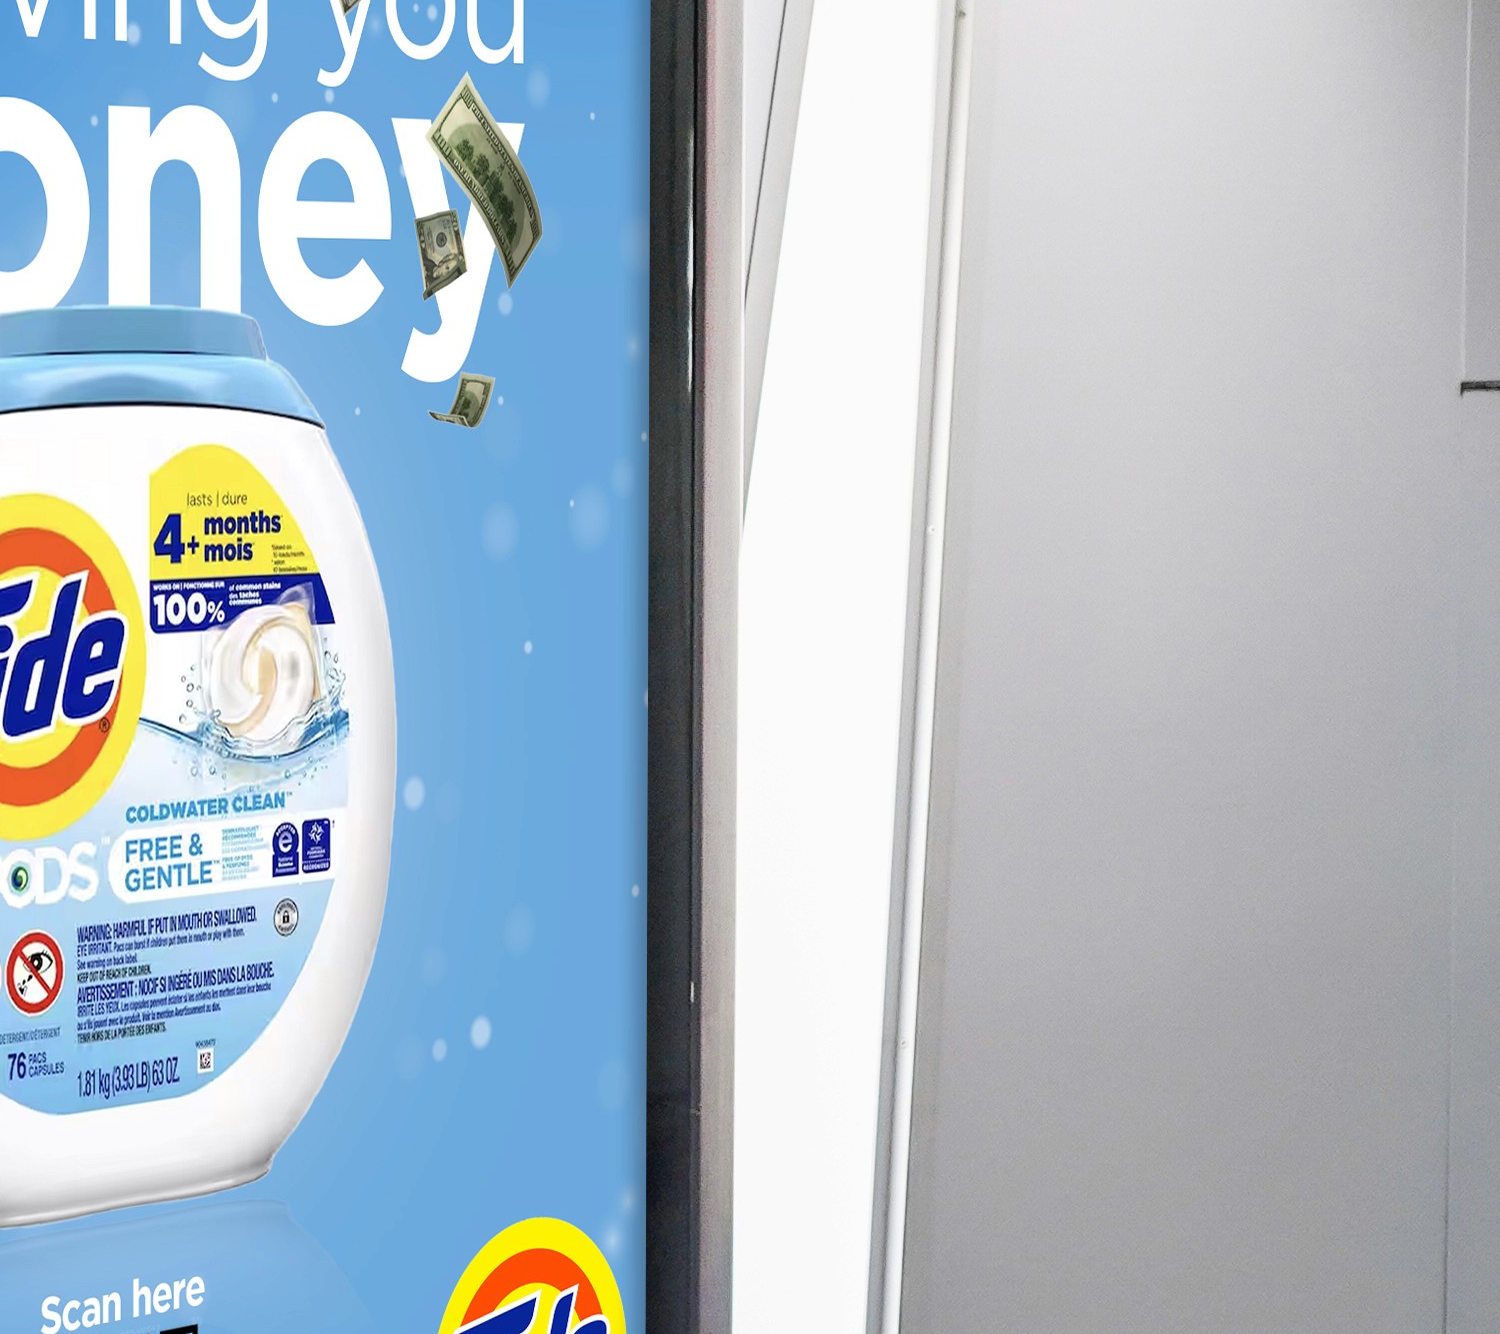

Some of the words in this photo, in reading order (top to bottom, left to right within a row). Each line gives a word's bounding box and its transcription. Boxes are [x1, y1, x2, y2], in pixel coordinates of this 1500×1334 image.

[187, 492, 213, 508] lasts
[222, 491, 248, 507] dure
[235, 582, 262, 591] common
[263, 581, 281, 590] stains
[239, 589, 260, 599] taches
[153, 592, 226, 626] 100%
[125, 797, 229, 824] COLDWATER
[125, 835, 183, 864] FREE
[188, 832, 204, 857] &
[77, 923, 112, 943] WARNING:
[113, 919, 147, 939] HARMFUL
[148, 918, 155, 935] IF
[155, 916, 169, 934] PUT
[169, 915, 177, 932] IN
[178, 913, 202, 931] MOUTH
[203, 911, 213, 928] OR
[214, 905, 258, 927] SWALLOWED.
[77, 980, 134, 1004] AVERTISSEMENT
[138, 977, 159, 997] NOCIF
[160, 976, 167, 993] SI
[168, 969, 192, 992] INGÉRÉ
[193, 971, 203, 989] OU
[203, 969, 217, 987] MIS
[217, 966, 236, 985] DANS
[236, 965, 246, 982] LA
[246, 961, 275, 981] BOUCHE.
[8, 1051, 27, 1081] 76
[28, 1051, 47, 1065] PACS
[28, 1061, 65, 1078] CAPSULES
[77, 1069, 96, 1098] 1.81
[98, 1068, 110, 1100] kg
[112, 1065, 135, 1097] (3.93
[136, 1060, 151, 1094] LB)
[152, 1059, 164, 1086] 63
[132, 1274, 206, 1319] here
